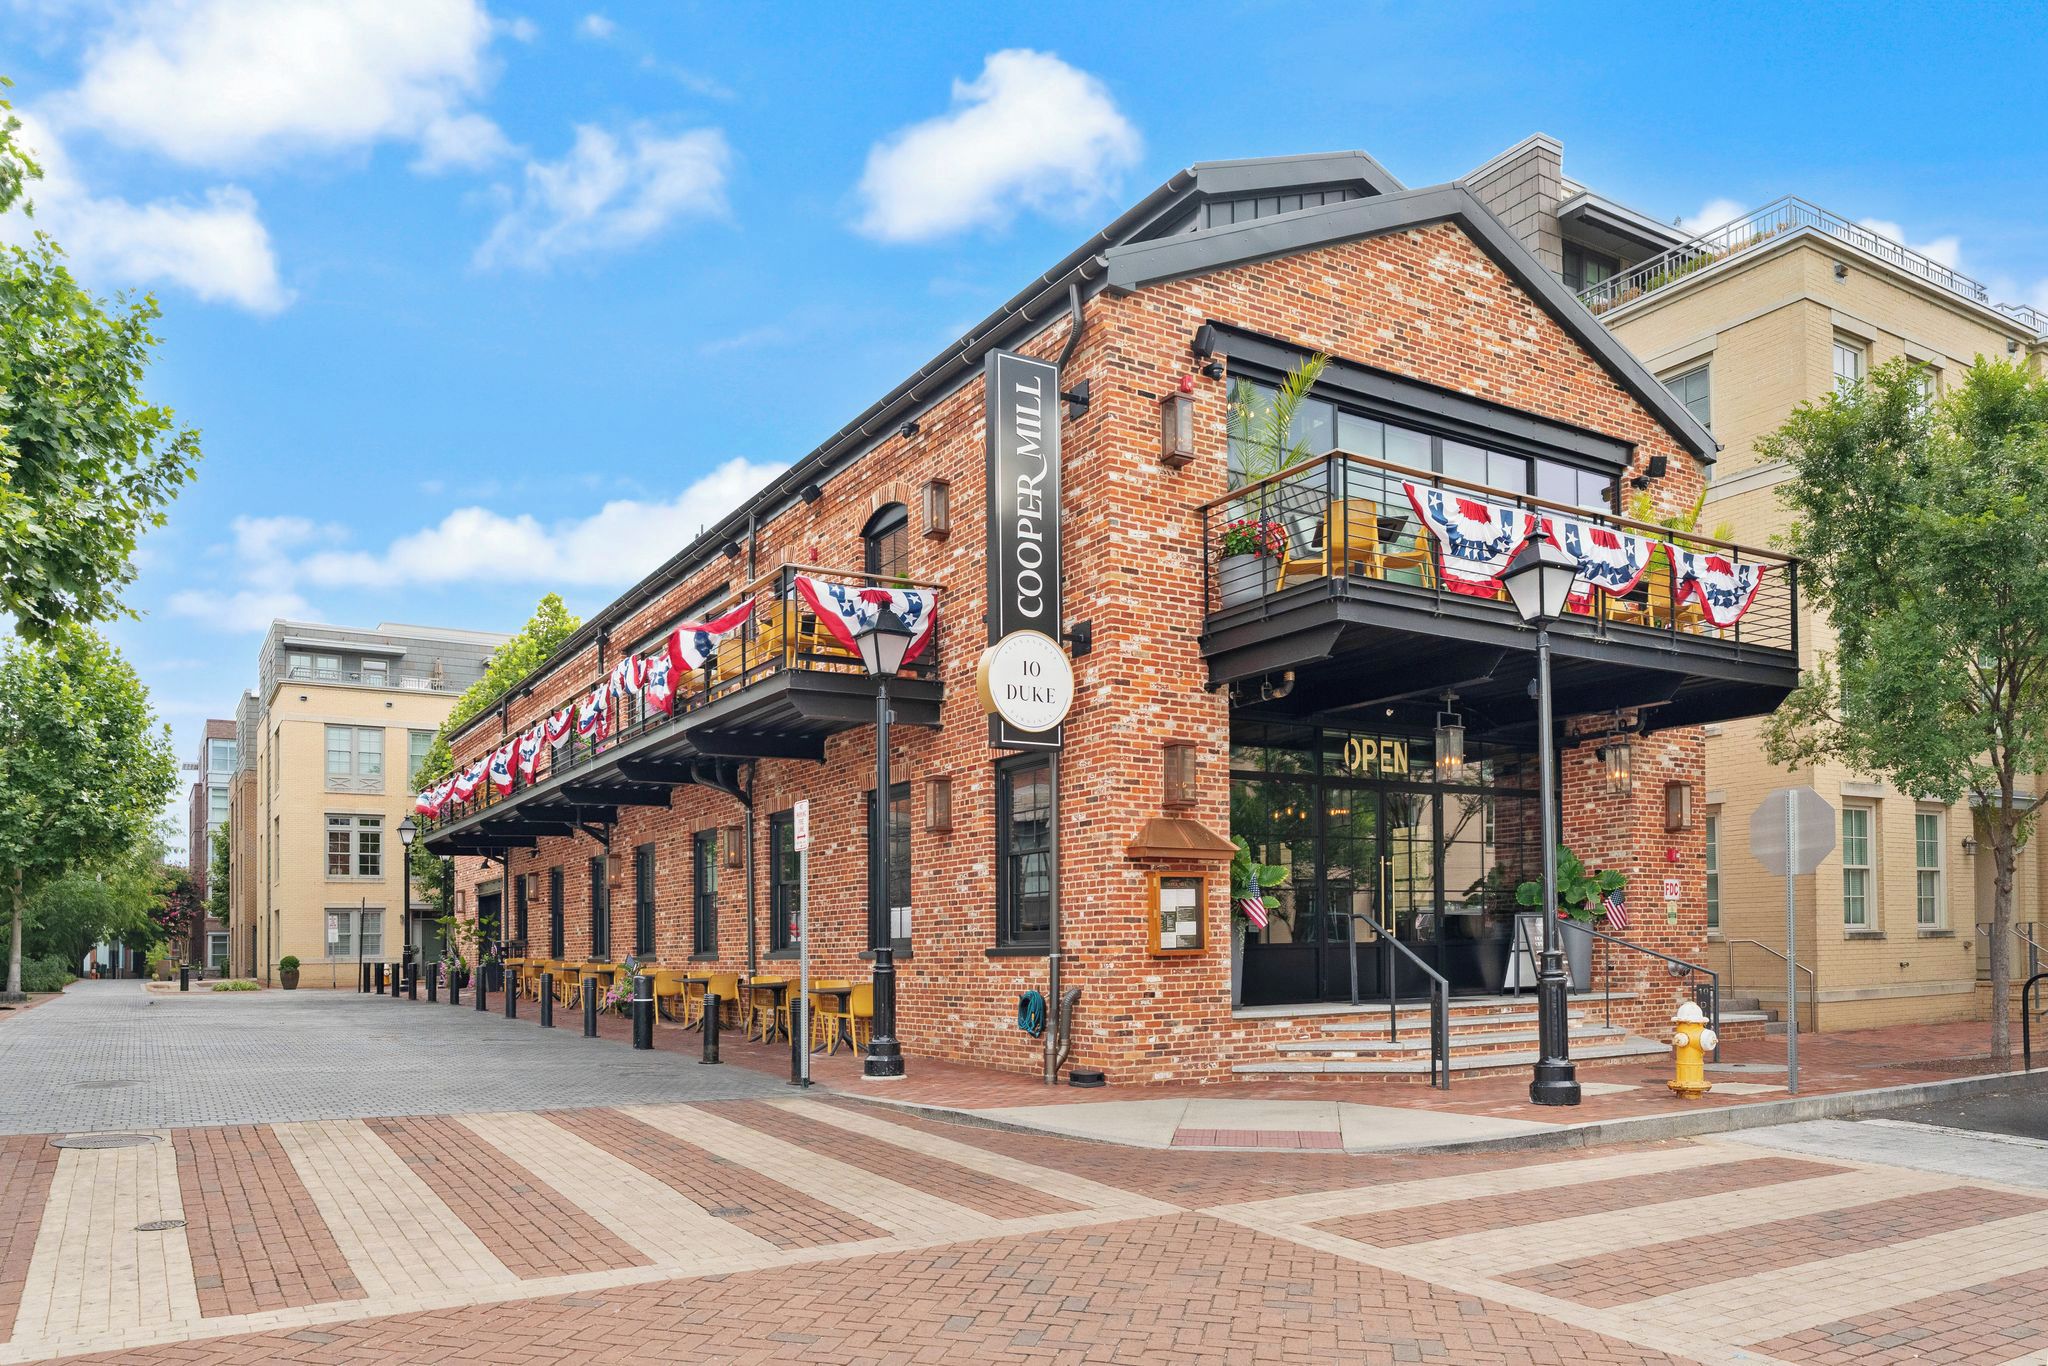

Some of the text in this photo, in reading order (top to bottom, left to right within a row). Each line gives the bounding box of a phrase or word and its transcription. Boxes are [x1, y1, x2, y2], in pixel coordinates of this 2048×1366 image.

[1015, 375, 1042, 460] MILL
[1016, 453, 1048, 618] COOPER
[1023, 660, 1041, 678] 10
[1006, 683, 1056, 704] DUKE
[1343, 737, 1409, 774] OPEN
[1665, 882, 1679, 896] FDC
